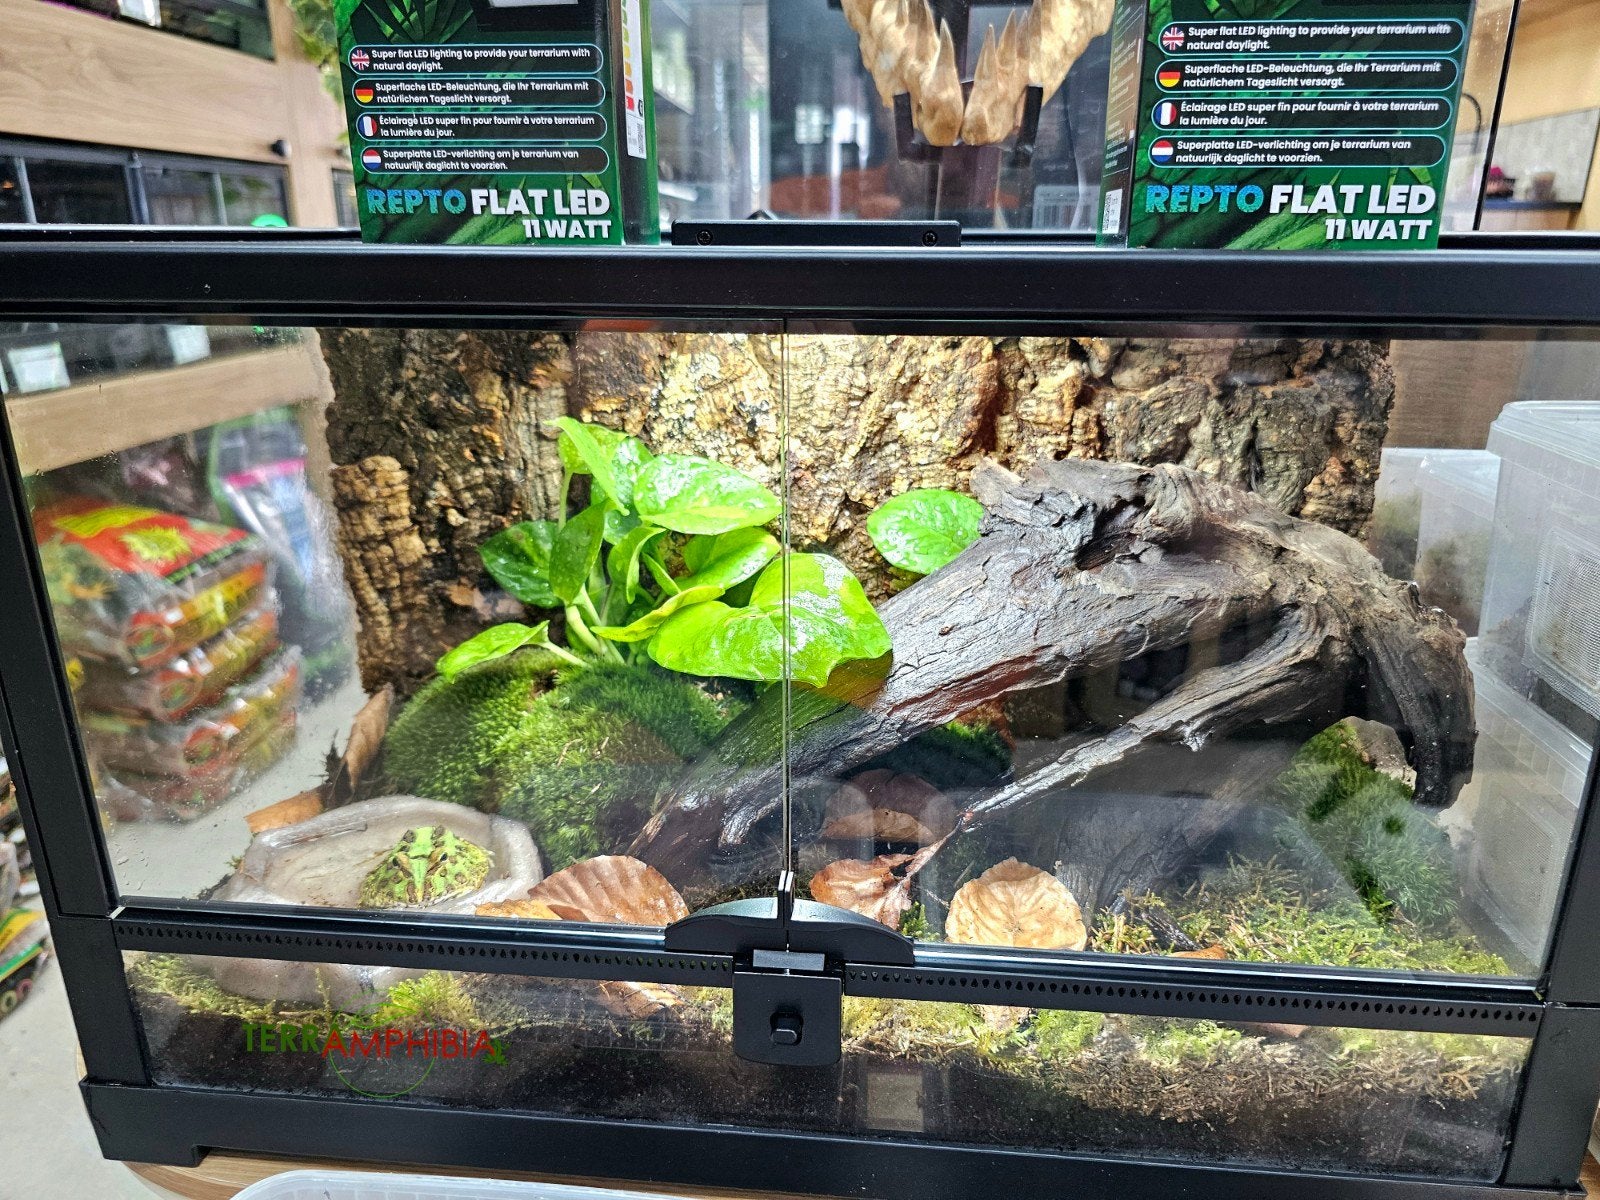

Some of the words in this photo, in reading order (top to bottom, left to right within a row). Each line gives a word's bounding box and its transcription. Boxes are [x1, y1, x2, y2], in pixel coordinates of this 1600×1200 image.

[1188, 26, 1218, 38] Super
[1220, 26, 1238, 36] flat
[1238, 26, 1256, 36] LED
[1257, 25, 1296, 38] lighting
[1298, 26, 1310, 36] to
[1310, 24, 1350, 37] provide
[1351, 26, 1376, 37] your
[1376, 24, 1426, 35] terrarium
[1428, 23, 1452, 34] with
[1186, 40, 1224, 50] natural
[1225, 40, 1270, 51] daylight.
[372, 50, 396, 61] Super
[398, 50, 412, 58] flat
[414, 50, 428, 58] LED
[430, 48, 463, 60] lighting
[464, 50, 473, 58] to
[474, 48, 506, 60] provide
[508, 50, 527, 60] your
[529, 48, 570, 58] terrarium
[572, 48, 590, 58] with
[373, 62, 404, 70] natural
[406, 62, 444, 72] daylight.
[1184, 64, 1245, 76] Superflache
[1246, 63, 1335, 75] LED-Beleuchtung,
[1337, 62, 1353, 72] die
[1354, 63, 1369, 72] Ihr
[1371, 62, 1421, 72] Terrarium
[1422, 62, 1442, 72] mit
[375, 82, 426, 93] Superflache
[428, 82, 501, 93] LED-Beleuchtung,
[502, 82, 516, 91] die
[518, 82, 529, 91] Ihr
[530, 82, 572, 91] Terrarium
[574, 82, 589, 91] mit
[1183, 78, 1245, 87] natürlichem
[1246, 77, 1299, 89] Tageslicht
[1300, 77, 1345, 88] versorgt.
[377, 94, 428, 103] natürlichem
[430, 94, 473, 105] Tageslicht
[474, 94, 512, 105] versorgt.
[1181, 101, 1227, 114] Éclairage
[1228, 102, 1246, 111] LED
[1247, 103, 1276, 114] super
[1277, 102, 1290, 111] fin
[1292, 102, 1316, 113] pour
[1317, 101, 1352, 111] fournir
[1353, 101, 1360, 111] à
[1362, 103, 1389, 111] votre
[1390, 101, 1439, 111] terrarium
[380, 115, 418, 127] Éclairage
[420, 116, 434, 125] LED
[435, 117, 458, 126] super
[460, 116, 472, 125] fin
[473, 118, 492, 126] pour
[494, 116, 522, 125] fournir
[523, 116, 530, 125] à
[531, 116, 552, 125] votre
[554, 116, 595, 125] terrarium
[1180, 116, 1189, 125] la
[1191, 116, 1228, 125] lumière
[1230, 116, 1244, 125] du
[1245, 116, 1268, 127] jour.
[380, 128, 389, 137] la
[390, 128, 422, 137] lumière
[424, 128, 435, 137] du
[436, 128, 455, 138] jour.
[1177, 140, 1234, 151] Superplatte
[1236, 140, 1311, 151] LED-verlichting
[1312, 141, 1329, 149] om
[1330, 140, 1341, 151] je
[1342, 140, 1390, 149] terrarium
[1392, 141, 1412, 149] van
[383, 150, 432, 160] Superplatte
[433, 150, 496, 160] LED-verlichting
[512, 150, 520, 160] je
[521, 149, 561, 158] terrarium
[1175, 154, 1222, 165] natuurlijk
[1224, 154, 1265, 165] daglicht
[1266, 154, 1277, 162] te
[1279, 154, 1323, 162] voorzien.
[385, 161, 424, 171] natuurlijk
[425, 161, 460, 171] daglicht
[461, 162, 470, 170] te
[471, 162, 508, 170] voorzien.
[366, 188, 466, 215] REPTO
[471, 188, 548, 215] FLAT
[550, 189, 610, 215] LED
[1145, 184, 1264, 214] REPTO
[1269, 184, 1364, 214] FLAT
[1368, 184, 1437, 214] LED
[522, 220, 542, 238] 11
[544, 220, 612, 238] WATT
[1325, 218, 1344, 240] 11
[1351, 218, 1432, 240] WATT
